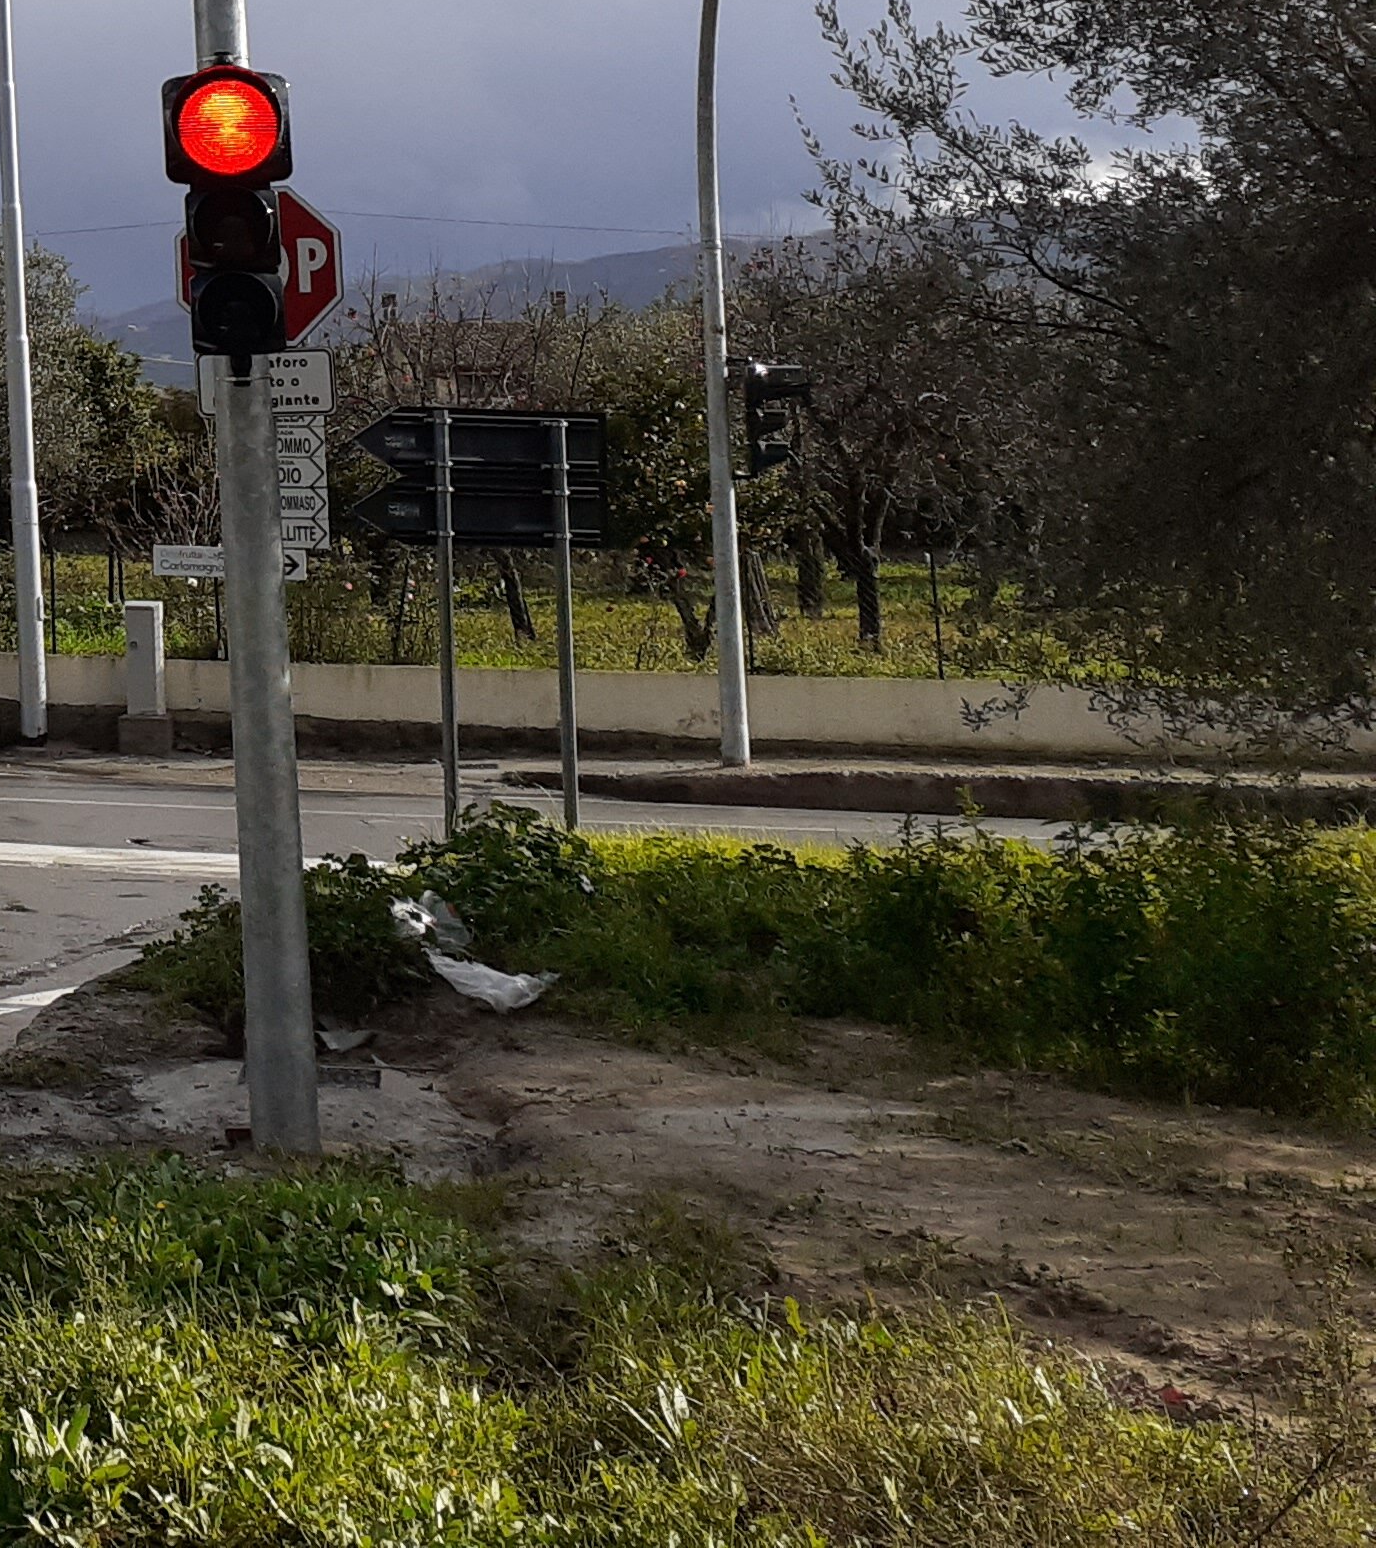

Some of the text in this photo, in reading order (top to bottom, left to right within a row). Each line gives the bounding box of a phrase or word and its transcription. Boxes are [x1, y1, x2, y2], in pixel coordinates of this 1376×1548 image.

[269, 357, 308, 369] aforo
[271, 394, 320, 408] giante
[277, 437, 311, 454] OMMO
[281, 495, 315, 510] OMMASO
